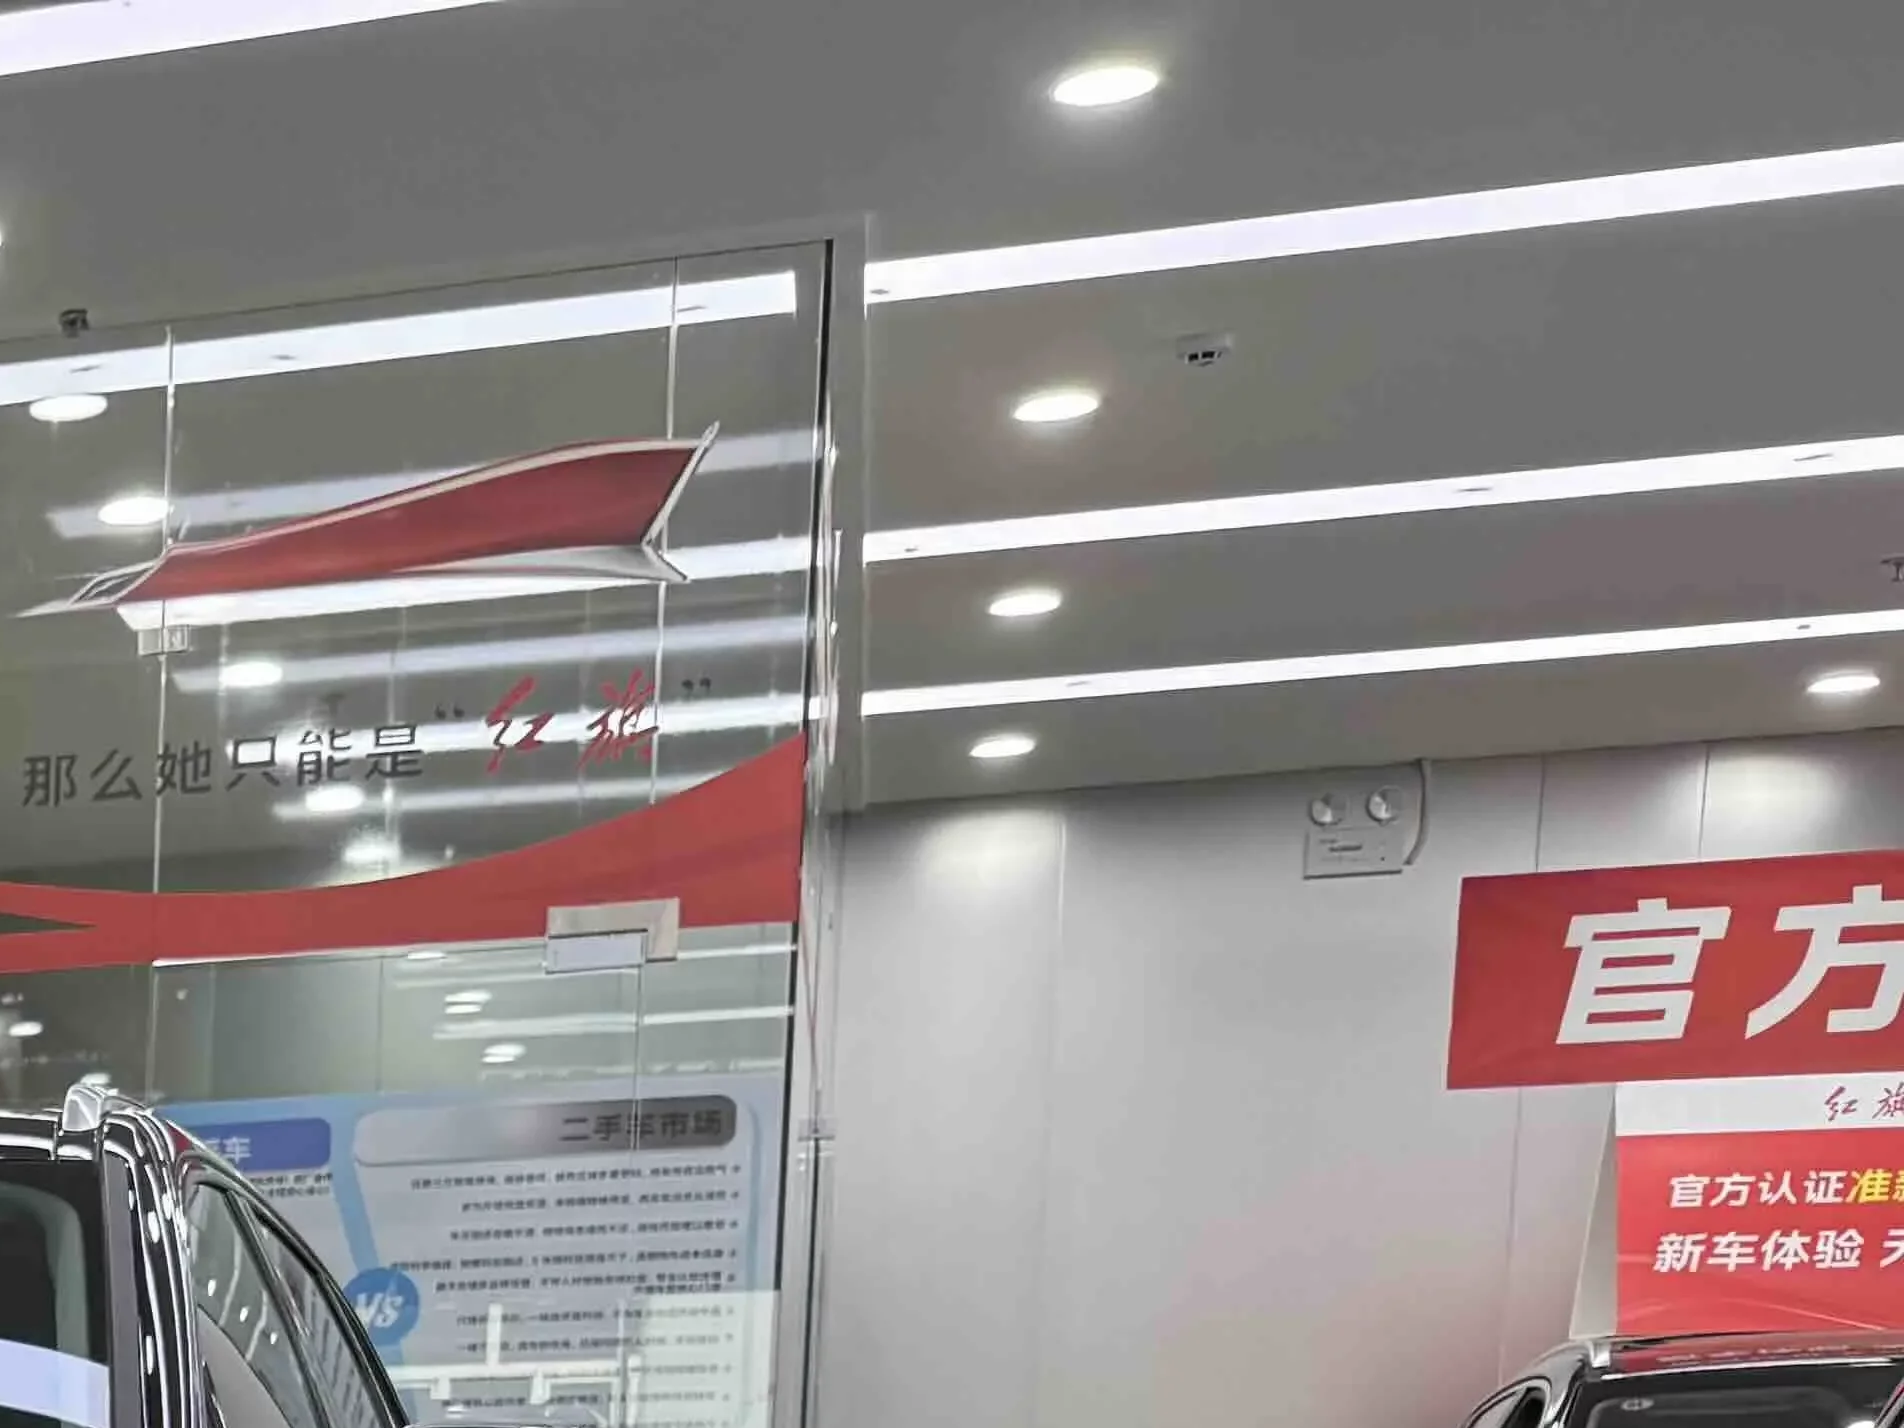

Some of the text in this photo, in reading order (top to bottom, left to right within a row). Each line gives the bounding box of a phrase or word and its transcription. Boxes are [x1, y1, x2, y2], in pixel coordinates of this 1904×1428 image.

[1555, 883, 1904, 1046] 官方
[559, 1109, 722, 1142] 二手车市场
[1652, 1226, 1865, 1274] 新车体验
[355, 1292, 403, 1328] VS
